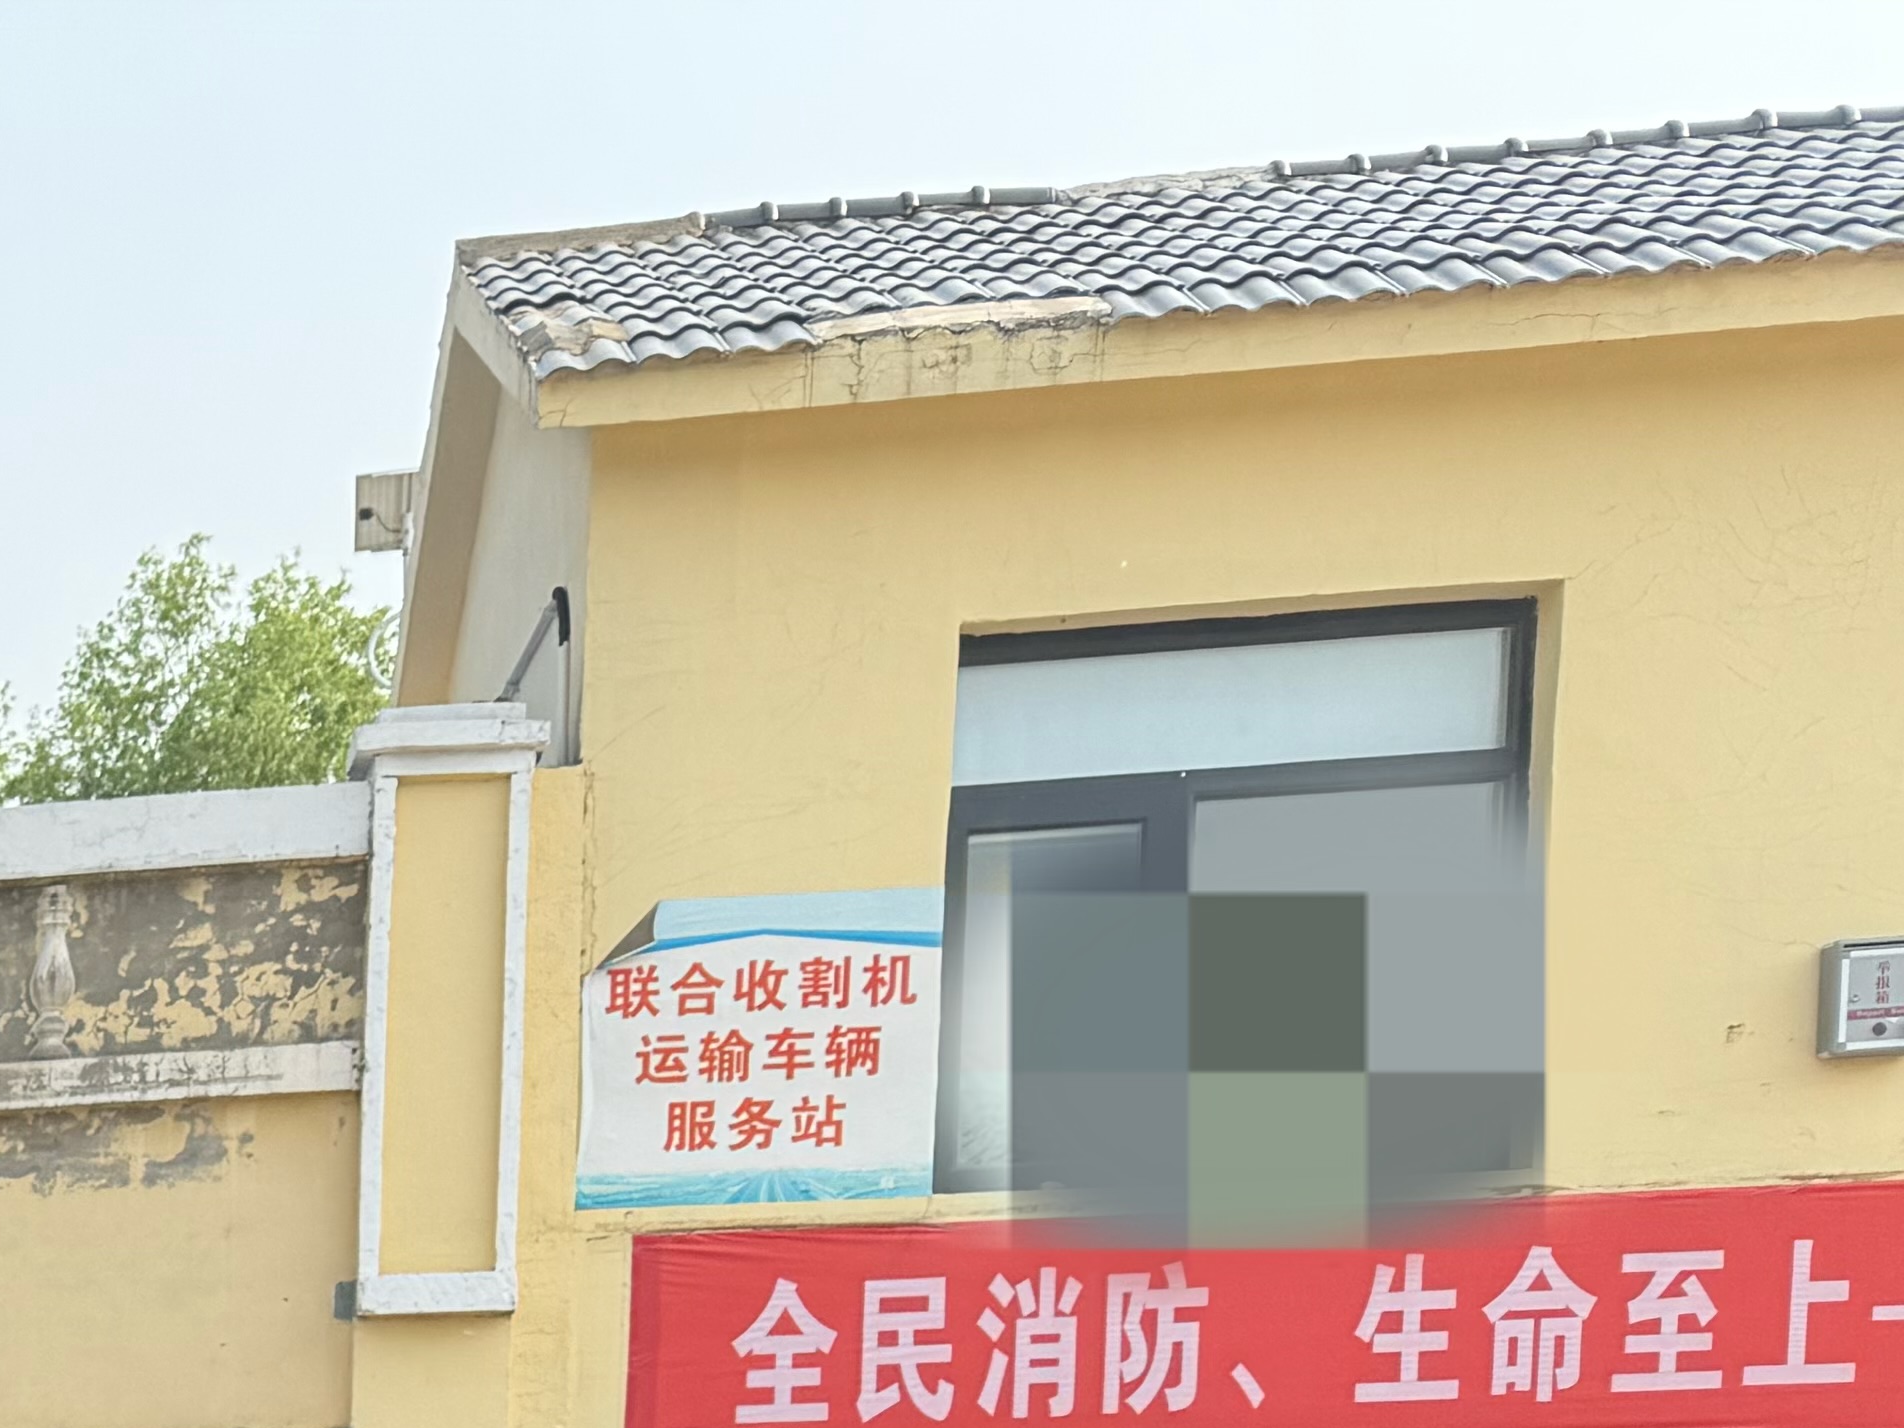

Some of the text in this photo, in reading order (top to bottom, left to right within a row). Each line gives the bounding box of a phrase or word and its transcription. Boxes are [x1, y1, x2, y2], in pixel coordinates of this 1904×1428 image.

[605, 953, 918, 1019] 联合收割机
[635, 1025, 883, 1085] 运输车辆
[663, 1095, 848, 1152] 服务站
